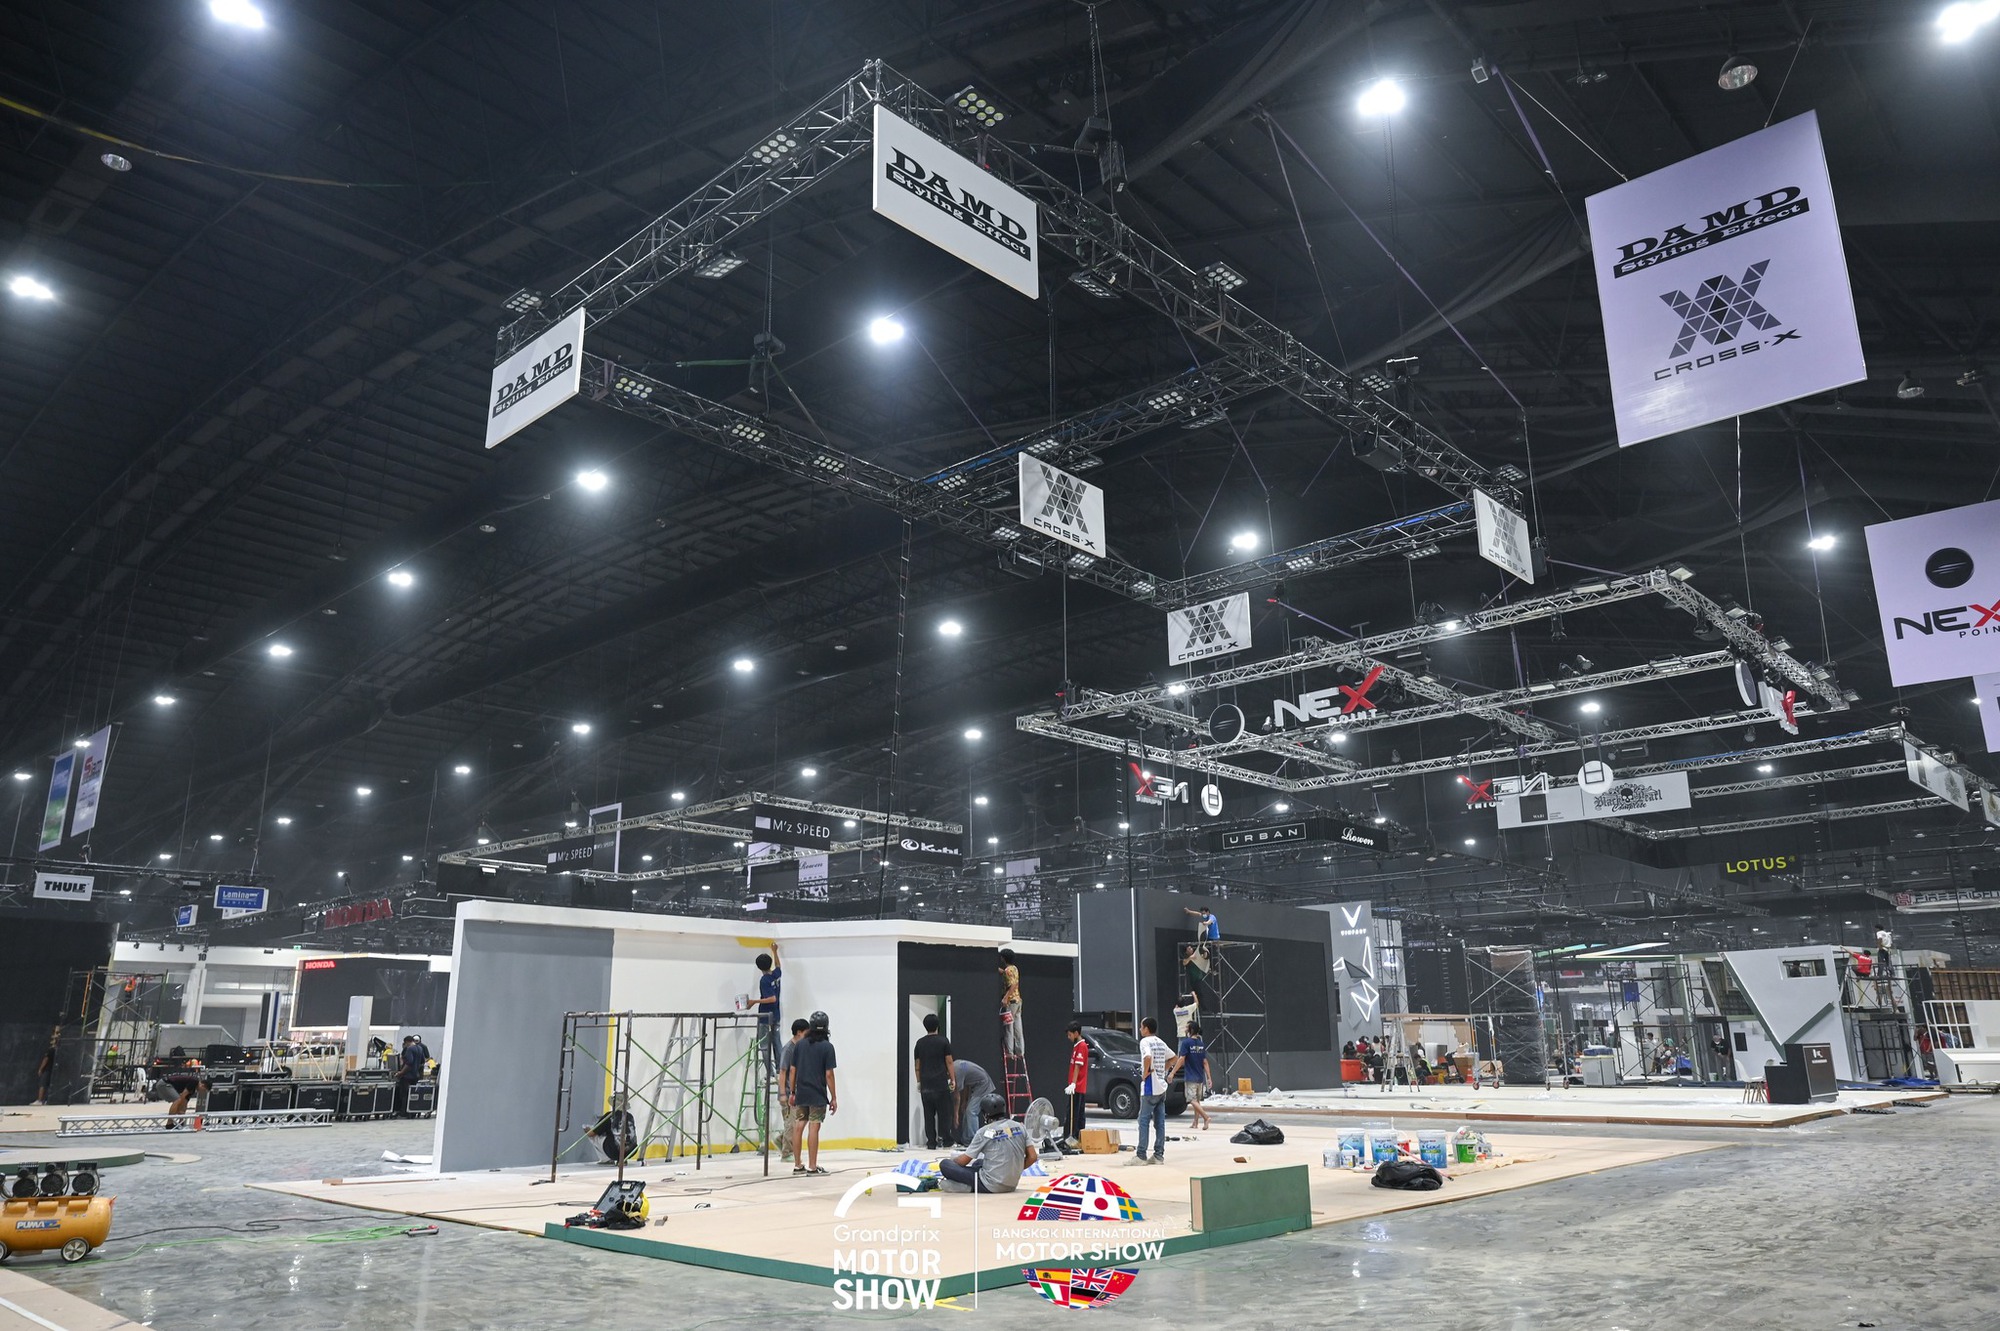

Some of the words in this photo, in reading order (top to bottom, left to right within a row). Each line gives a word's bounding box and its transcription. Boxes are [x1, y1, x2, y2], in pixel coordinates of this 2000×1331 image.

[891, 147, 1027, 240] DAMD
[892, 170, 964, 221] Styling
[972, 216, 1026, 255] Effect
[1616, 186, 1801, 262] DAMD
[1621, 237, 1710, 273] Styling
[1721, 204, 1801, 239] Effect
[496, 343, 572, 404] DAMD
[495, 385, 533, 414] Styling
[537, 360, 570, 387] Effect
[1274, 666, 1385, 727] NEX
[1328, 708, 1378, 725] POINT
[797, 822, 830, 838] SPEED
[1230, 828, 1298, 844] URBAN
[571, 847, 593, 860] SPEED
[1726, 856, 1787, 873] LOTUS
[44, 881, 87, 894] THULE
[324, 898, 394, 930] HONDA
[198, 953, 207, 961] 10
[305, 961, 335, 970] HONDA
[16, 1220, 45, 1229] PUMA
